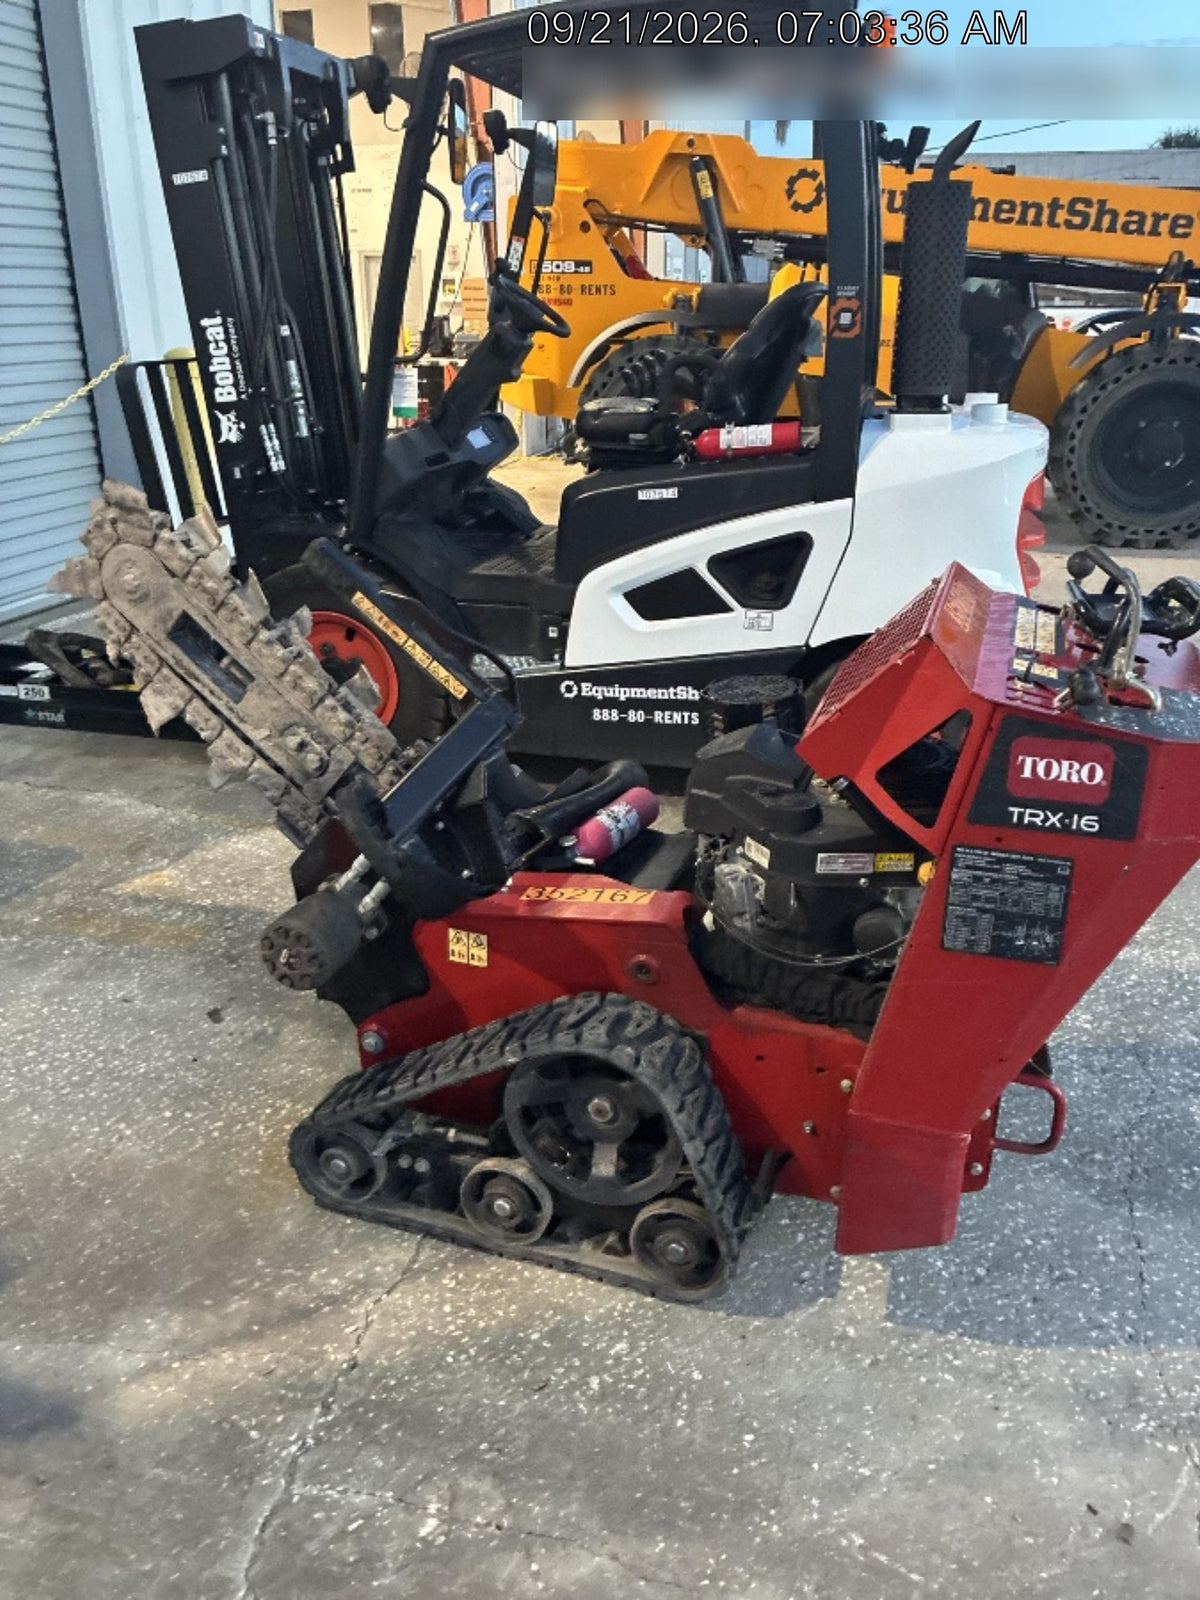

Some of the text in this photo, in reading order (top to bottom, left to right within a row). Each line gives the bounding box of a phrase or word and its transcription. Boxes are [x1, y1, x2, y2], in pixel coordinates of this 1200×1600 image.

[538, 284, 616, 296] 88-80-RENTS
[200, 316, 239, 403] Bobcat
[23, 687, 45, 698] 250
[580, 682, 700, 701] EquipmentSh
[592, 708, 700, 724] 888-80-RENTS
[1017, 755, 1105, 785] TORO
[525, 887, 650, 902] 352167
